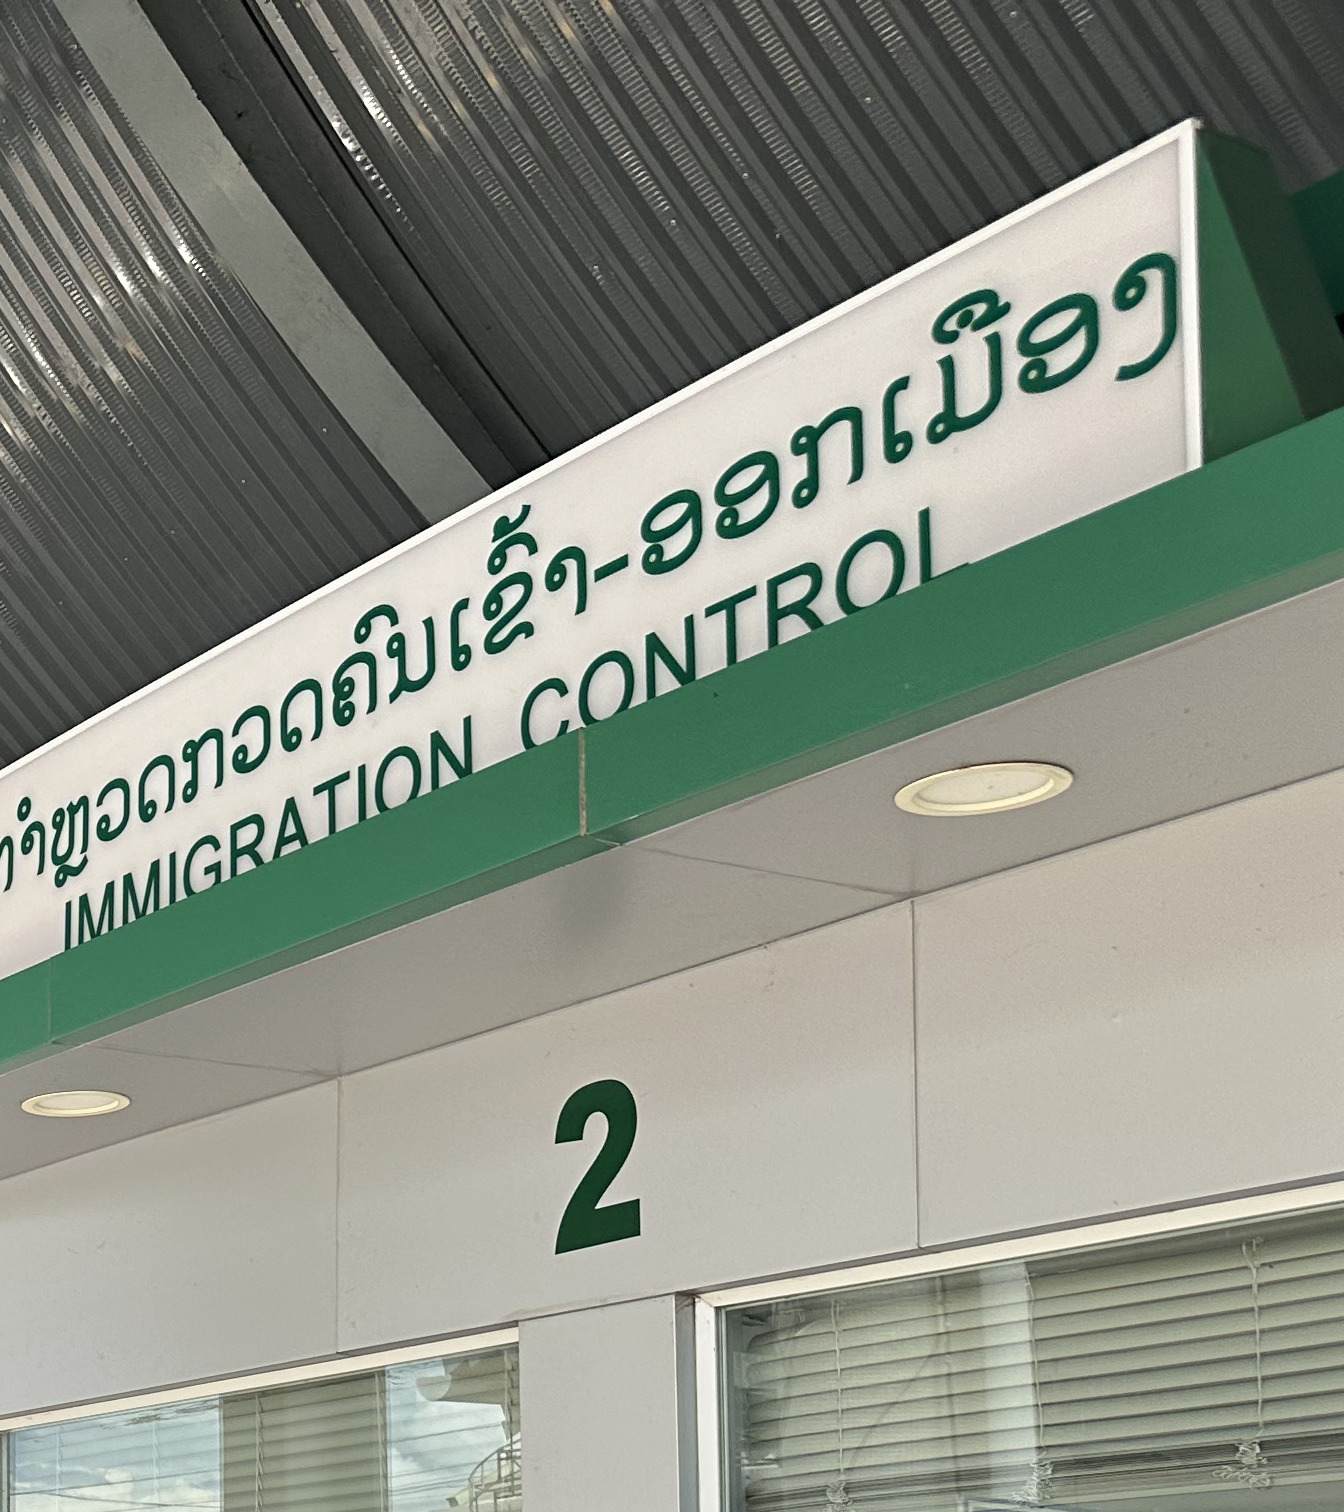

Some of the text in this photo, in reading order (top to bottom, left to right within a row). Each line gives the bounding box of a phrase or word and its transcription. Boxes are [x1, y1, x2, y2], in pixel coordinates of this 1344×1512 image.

[64, 506, 971, 952] IMMIGRATION CONTROL
[554, 1078, 641, 1256] 2
